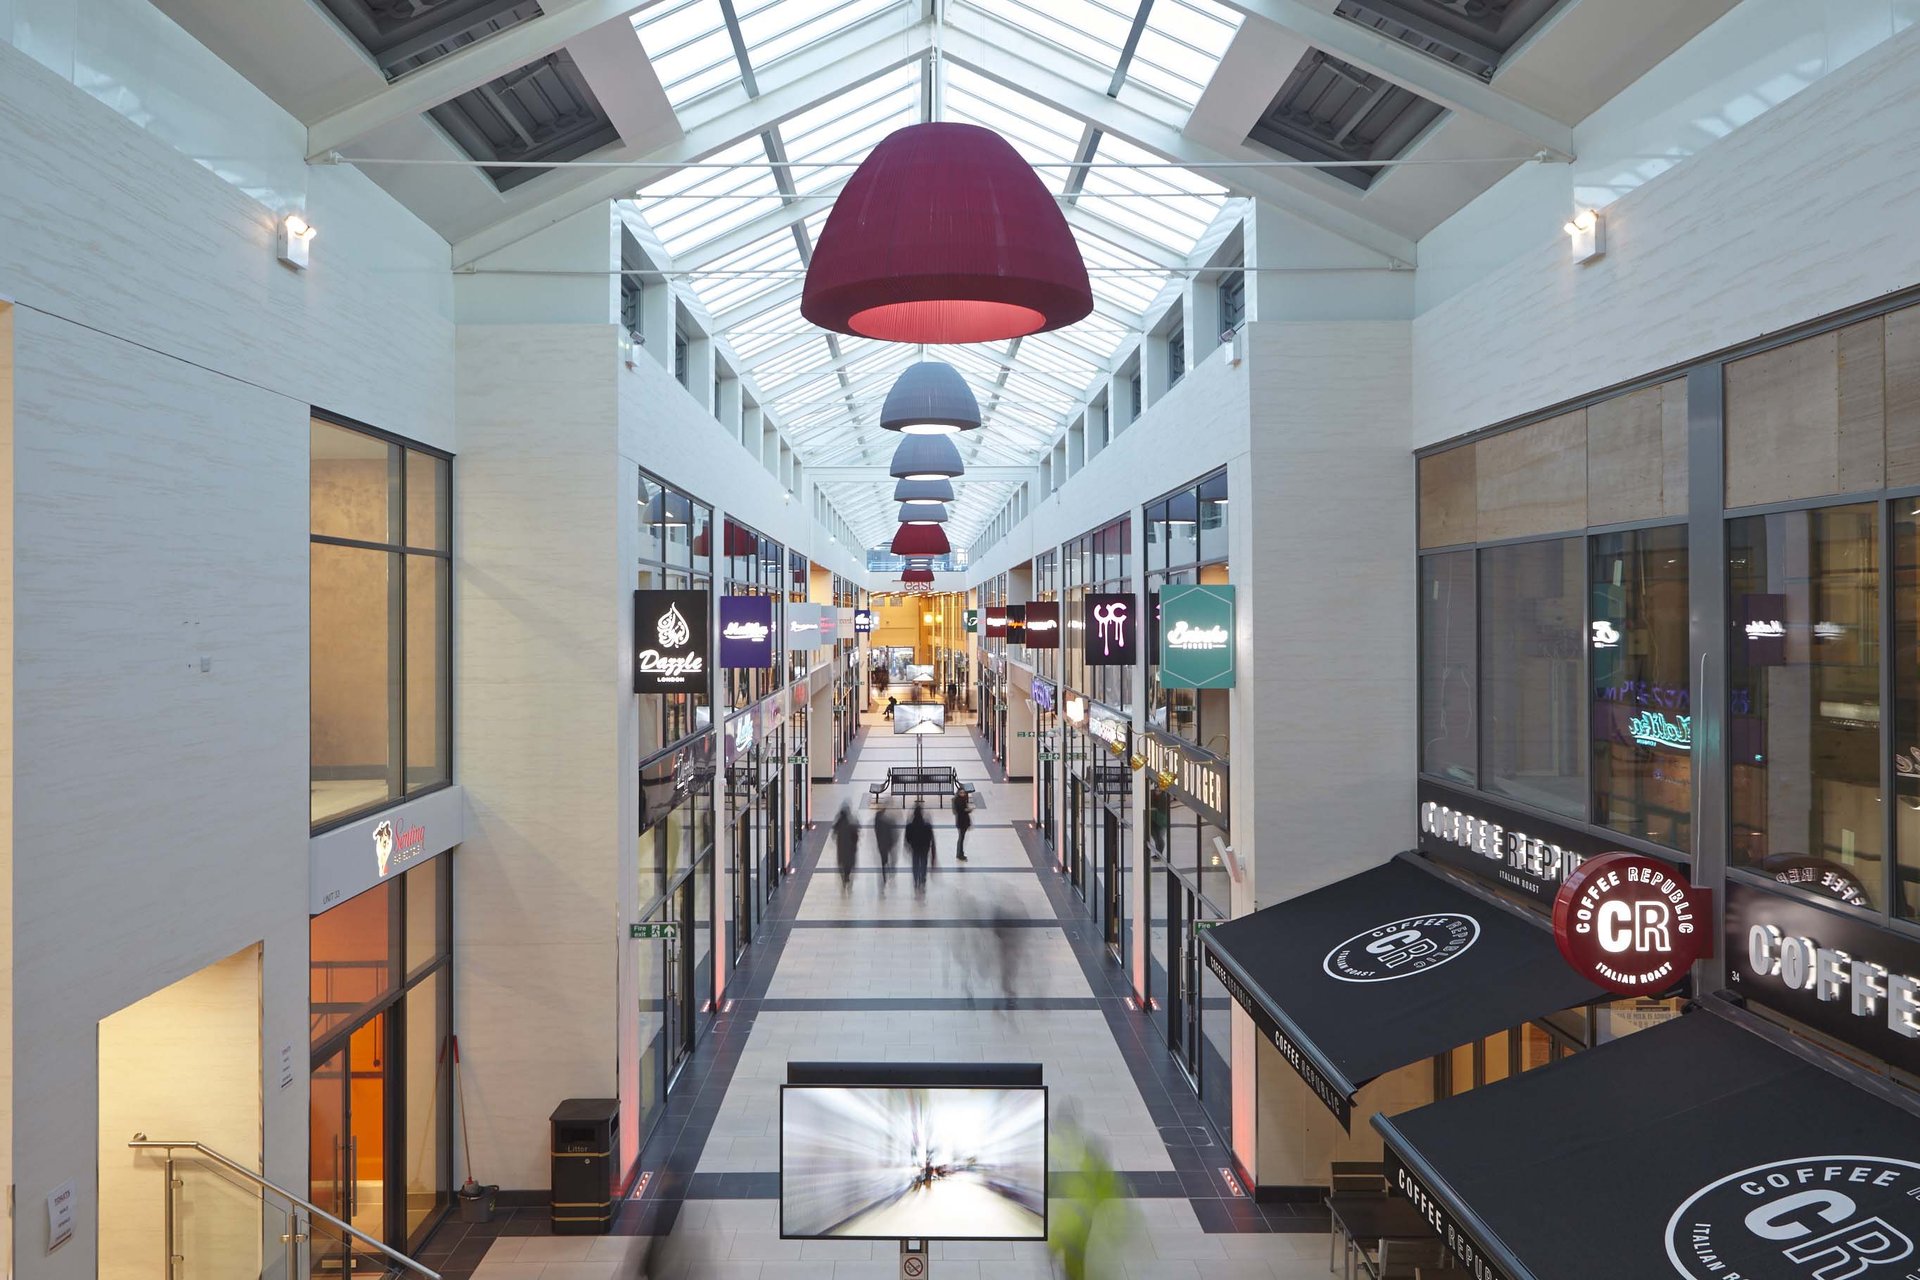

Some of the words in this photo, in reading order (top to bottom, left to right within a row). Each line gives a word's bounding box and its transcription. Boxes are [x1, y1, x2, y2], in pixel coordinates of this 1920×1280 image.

[904, 581, 934, 591] east
[639, 649, 702, 676] Dazzle
[1184, 759, 1222, 813] BURGER
[1421, 801, 1504, 860] COFFEE
[1507, 831, 1587, 884] REPU
[1499, 870, 1520, 886] ITALIAN
[1521, 880, 1540, 894] ROAST
[1576, 871, 1620, 934] COFFEE
[1628, 867, 1694, 934] REPUBLIC
[1372, 918, 1449, 938] COFFEE
[1413, 920, 1469, 969] REPUBLIC
[1597, 900, 1672, 953] CR
[1366, 929, 1438, 969] CR
[1209, 955, 1228, 985] COFFEE
[1344, 967, 1376, 977] ROAST
[1595, 962, 1637, 985] ITALIAN
[1640, 961, 1673, 985] ROAST
[1731, 970, 1740, 983] 34
[1274, 1030, 1300, 1070] COFFEE
[1301, 1060, 1340, 1115] REPUBLIC
[567, 1145, 588, 1153] Litter
[1398, 1168, 1443, 1234] COFFEE
[1740, 1166, 1901, 1196] COFFEE
[1692, 1222, 1727, 1272] ITALIAN
[1744, 1189, 1914, 1280] CR
